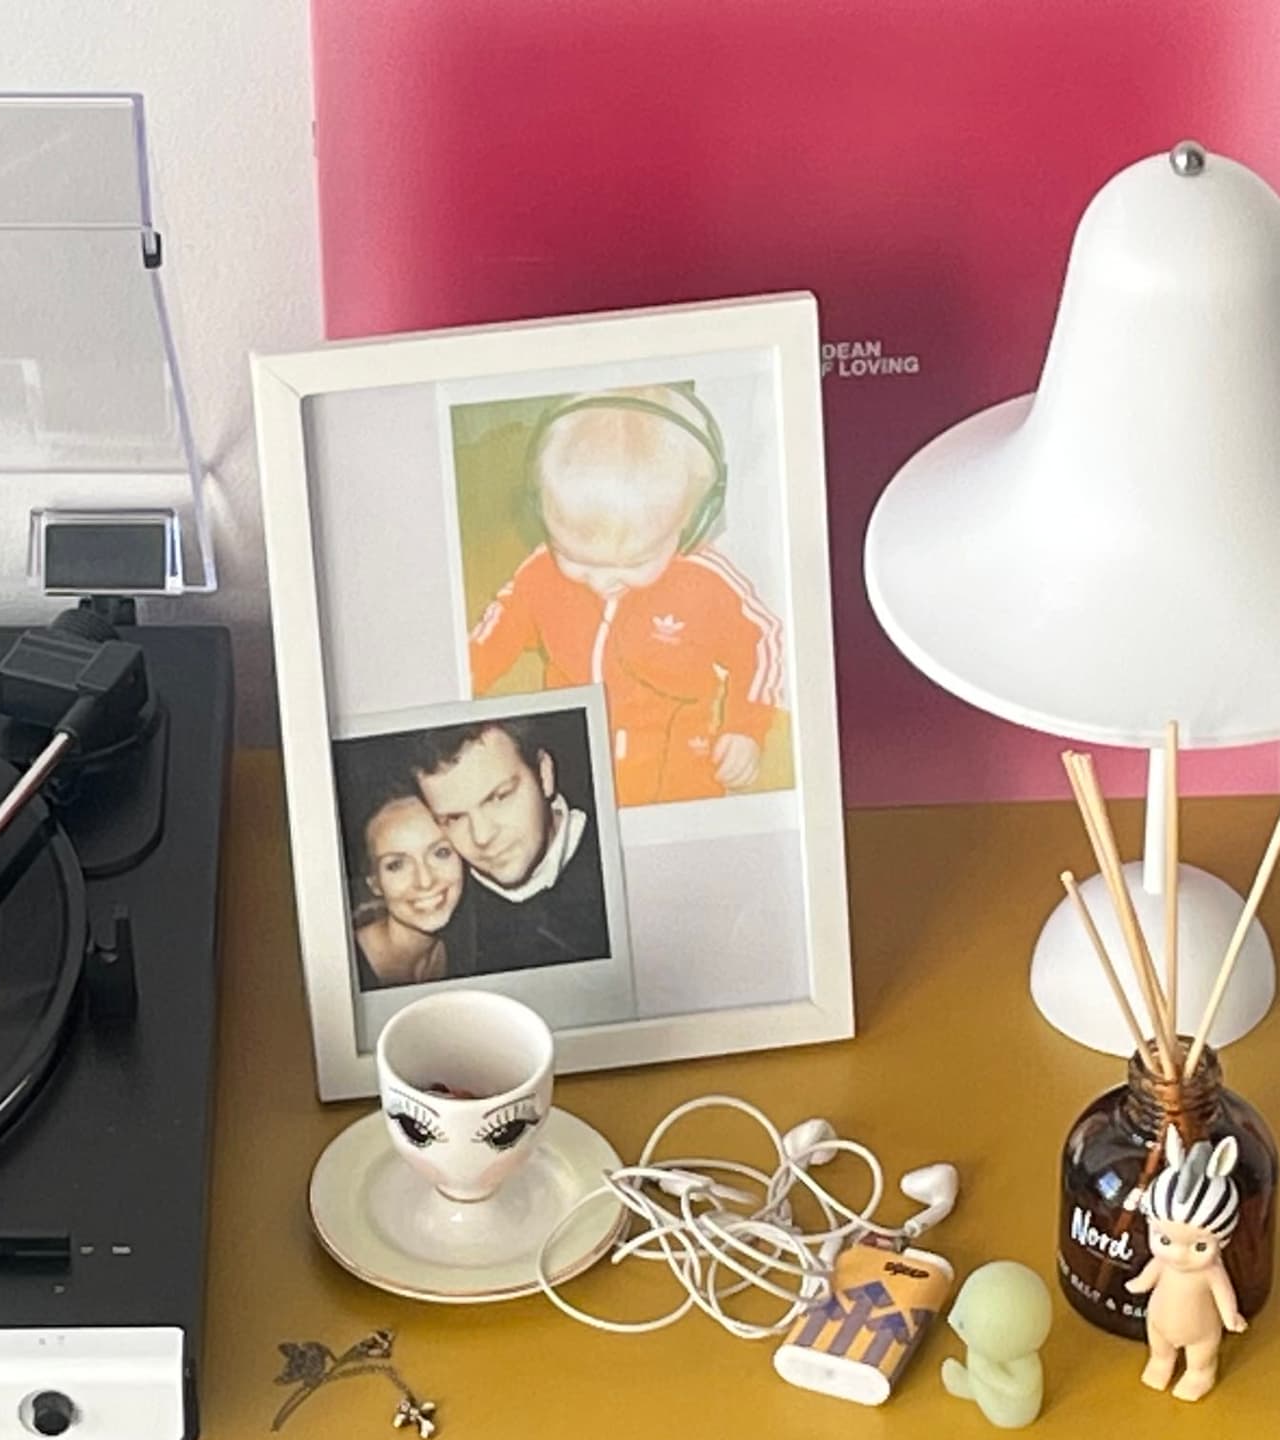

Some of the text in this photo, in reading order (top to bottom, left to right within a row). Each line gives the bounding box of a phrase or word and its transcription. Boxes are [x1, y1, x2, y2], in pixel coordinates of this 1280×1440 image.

[822, 341, 882, 359] DEAN
[839, 356, 919, 376] LOVING
[1071, 1205, 1133, 1260] Nord
